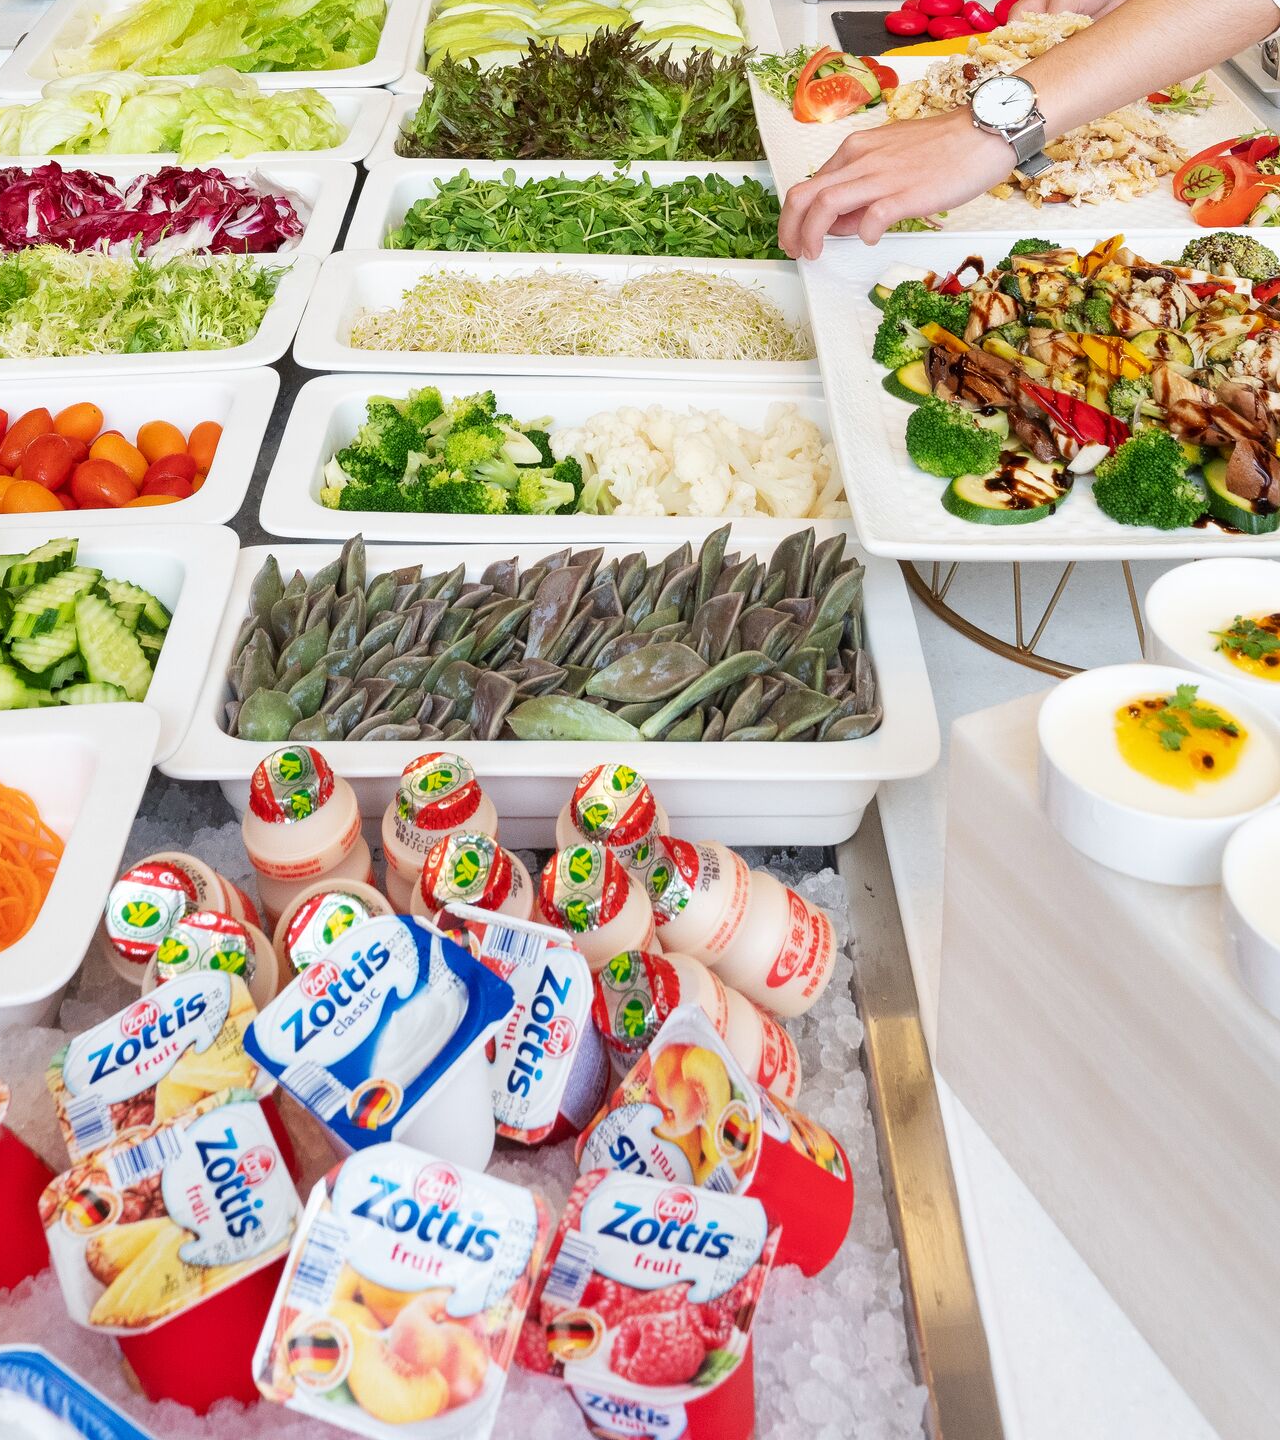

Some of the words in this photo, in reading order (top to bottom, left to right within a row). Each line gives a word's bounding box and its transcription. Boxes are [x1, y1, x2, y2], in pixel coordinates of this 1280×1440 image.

[280, 941, 391, 1053] Zottis
[333, 987, 381, 1037] classic
[88, 993, 207, 1085] Zottis
[501, 1004, 525, 1050] fruit
[507, 964, 572, 1098] Zottis
[135, 1042, 179, 1075] fruit
[195, 1127, 264, 1238] Zottis
[651, 1143, 676, 1182] fruit
[186, 1184, 211, 1225] fruit
[351, 1174, 500, 1262] Zottis
[598, 1201, 734, 1259] Zottis
[390, 1243, 443, 1276] fruit
[632, 1253, 682, 1276] fruit
[583, 1391, 670, 1428] Zottis
